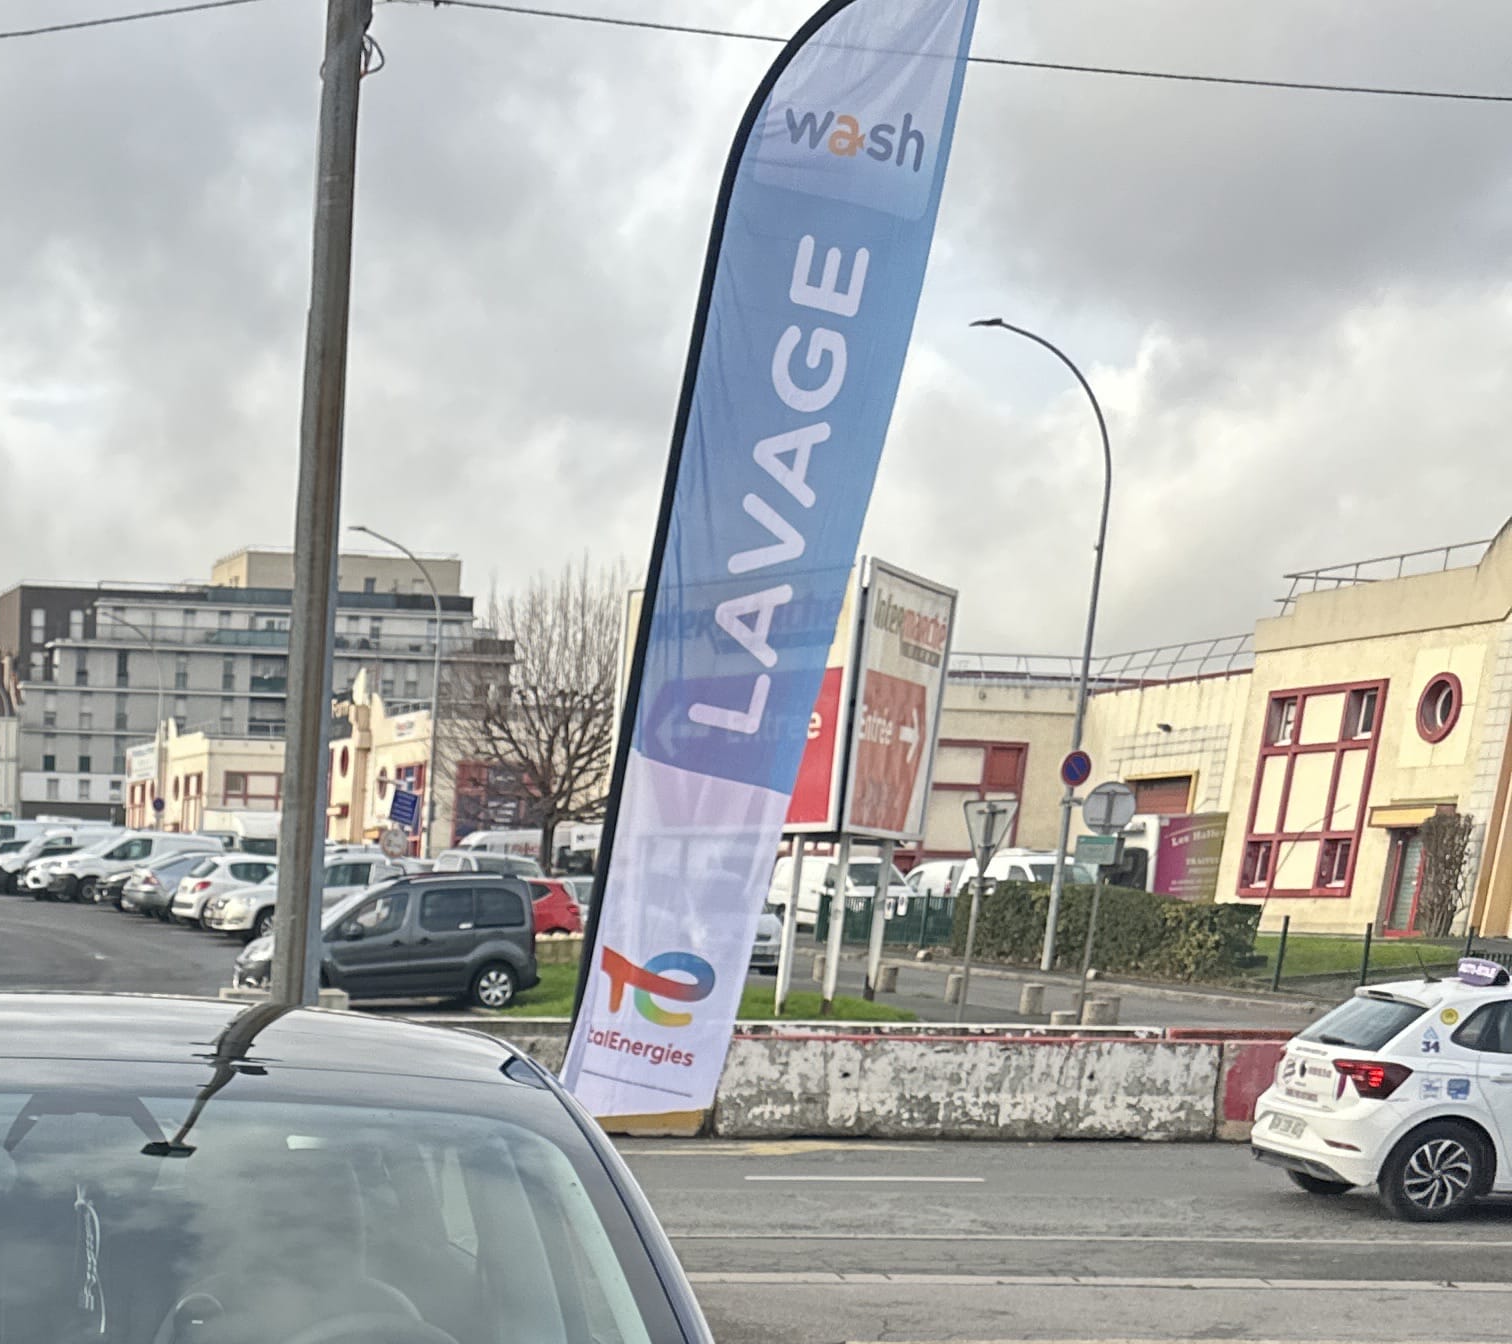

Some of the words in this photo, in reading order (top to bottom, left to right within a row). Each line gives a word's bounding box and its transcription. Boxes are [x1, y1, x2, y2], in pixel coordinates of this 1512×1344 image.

[785, 106, 925, 174] wash
[688, 234, 870, 735] LAVAGE
[859, 703, 895, 747] Entrée
[1420, 1040, 1441, 1054] 34
